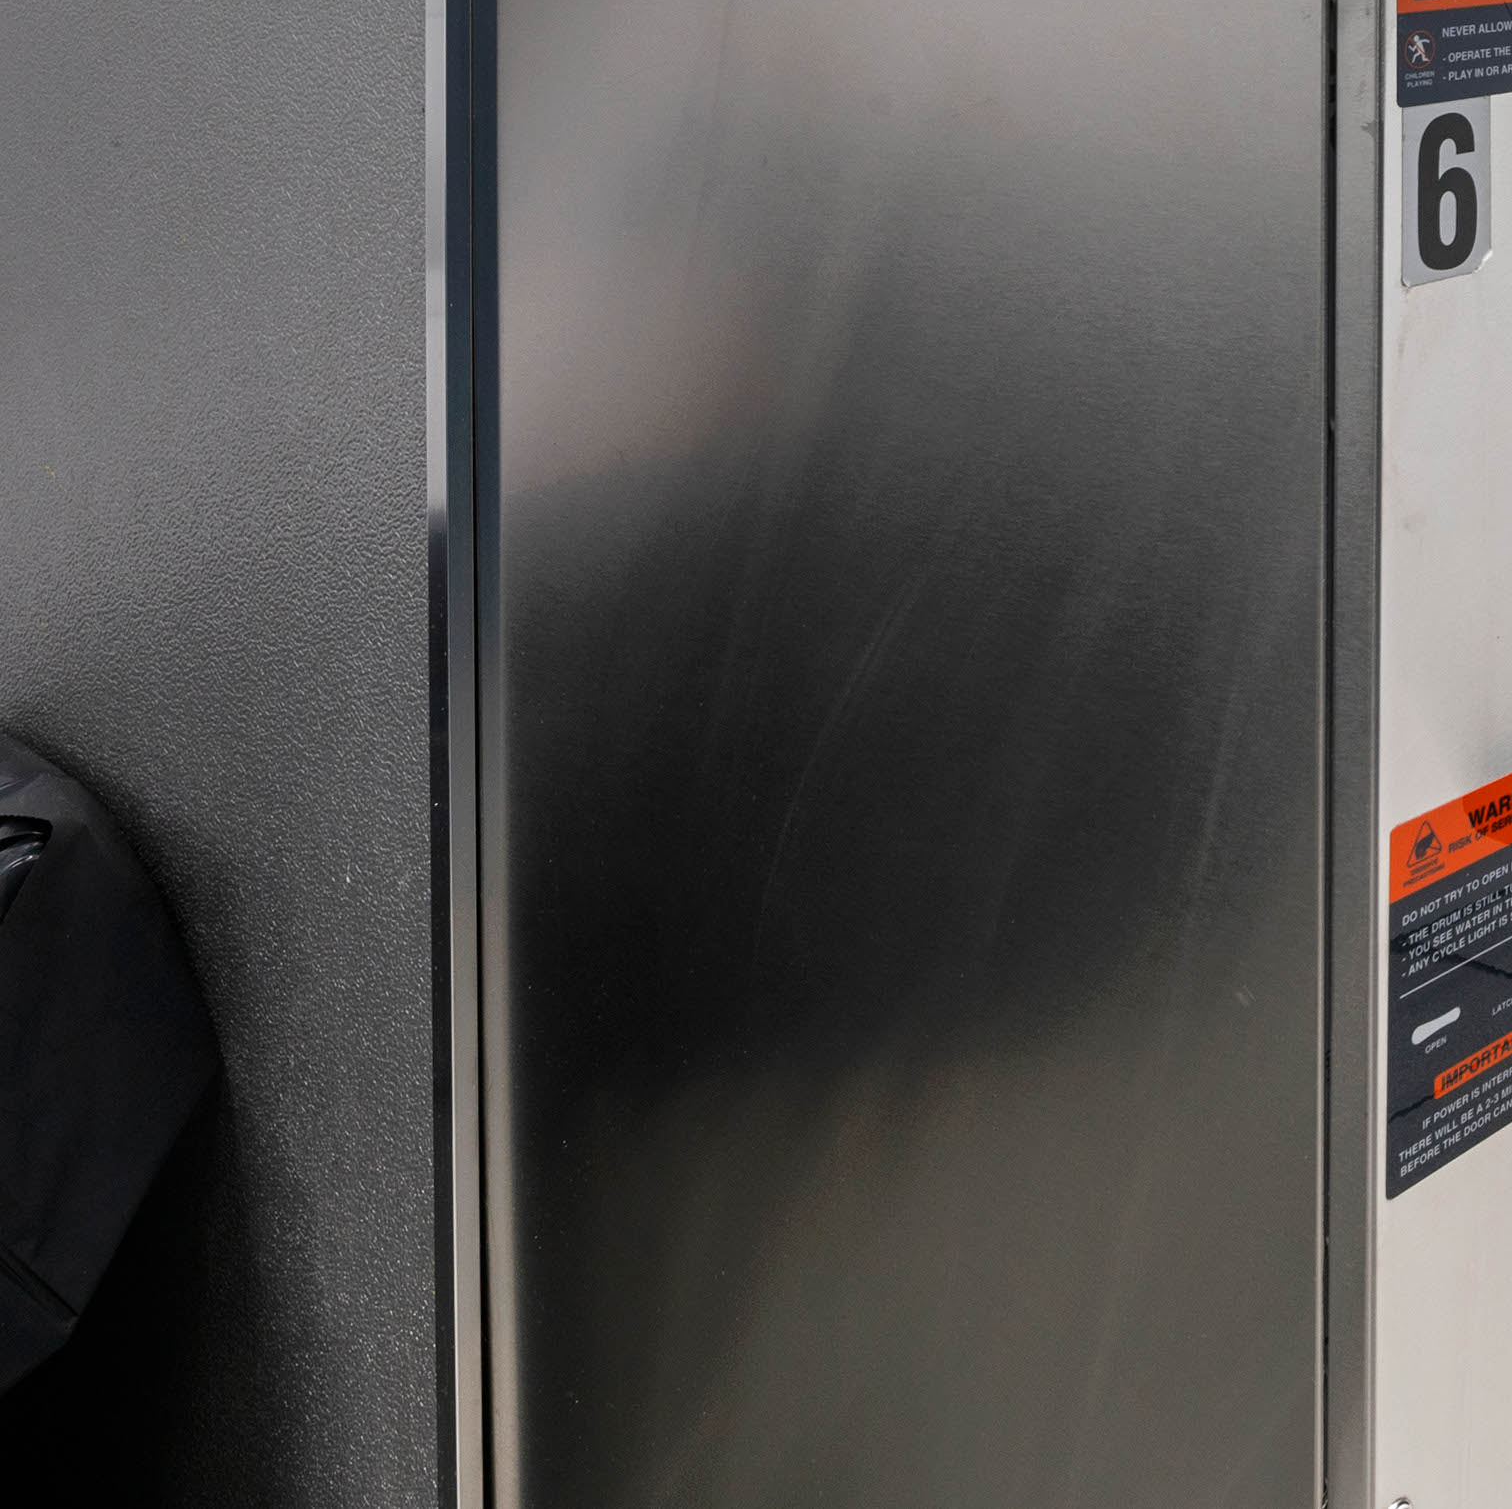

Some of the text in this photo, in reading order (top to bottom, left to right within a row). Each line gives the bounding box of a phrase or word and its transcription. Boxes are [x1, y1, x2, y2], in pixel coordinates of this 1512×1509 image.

[1442, 24, 1476, 38] NEVER
[1478, 20, 1512, 35] ALLOW
[1404, 69, 1436, 81] CHILDREN
[1448, 48, 1492, 63] OPERATE
[1494, 44, 1512, 57] THE
[1448, 68, 1473, 82] PLAY
[1474, 67, 1484, 78] IN
[1486, 64, 1500, 77] OR
[1406, 79, 1433, 89] PLAYING
[1418, 112, 1478, 271] 6
[1448, 835, 1473, 854] RISK
[1475, 825, 1490, 841] OF
[1402, 911, 1418, 926] DO
[1420, 897, 1442, 916] NOT
[1444, 886, 1464, 904] TRY
[1466, 879, 1480, 893] TO
[1482, 863, 1509, 885] OPEN
[1409, 926, 1429, 945] THE
[1431, 912, 1460, 931] DRUM
[1463, 903, 1473, 917] IS
[1475, 890, 1501, 911] STILL
[1409, 941, 1431, 960] YOU
[1433, 929, 1453, 948] SEE
[1455, 909, 1490, 936] WATER
[1492, 903, 1503, 916] IN
[1408, 956, 1430, 976] ANY
[1432, 937, 1466, 963] CYCLE
[1467, 920, 1497, 944] LIGHT
[1498, 914, 1508, 927] IS
[1424, 1036, 1447, 1054] OPEN
[1399, 1133, 1432, 1163] THERE
[1435, 1120, 1459, 1140] WILL
[1460, 1108, 1474, 1124] BE
[1476, 1103, 1483, 1115] A
[1485, 1092, 1499, 1110] 2-3
[1422, 1116, 1432, 1130] IF
[1433, 1093, 1469, 1123] POWER
[1471, 1087, 1480, 1100] IS
[1400, 1144, 1441, 1177] BEFORE
[1442, 1131, 1461, 1149] THE
[1463, 1112, 1491, 1137] DOOR
[1493, 1098, 1512, 1117] CAN
